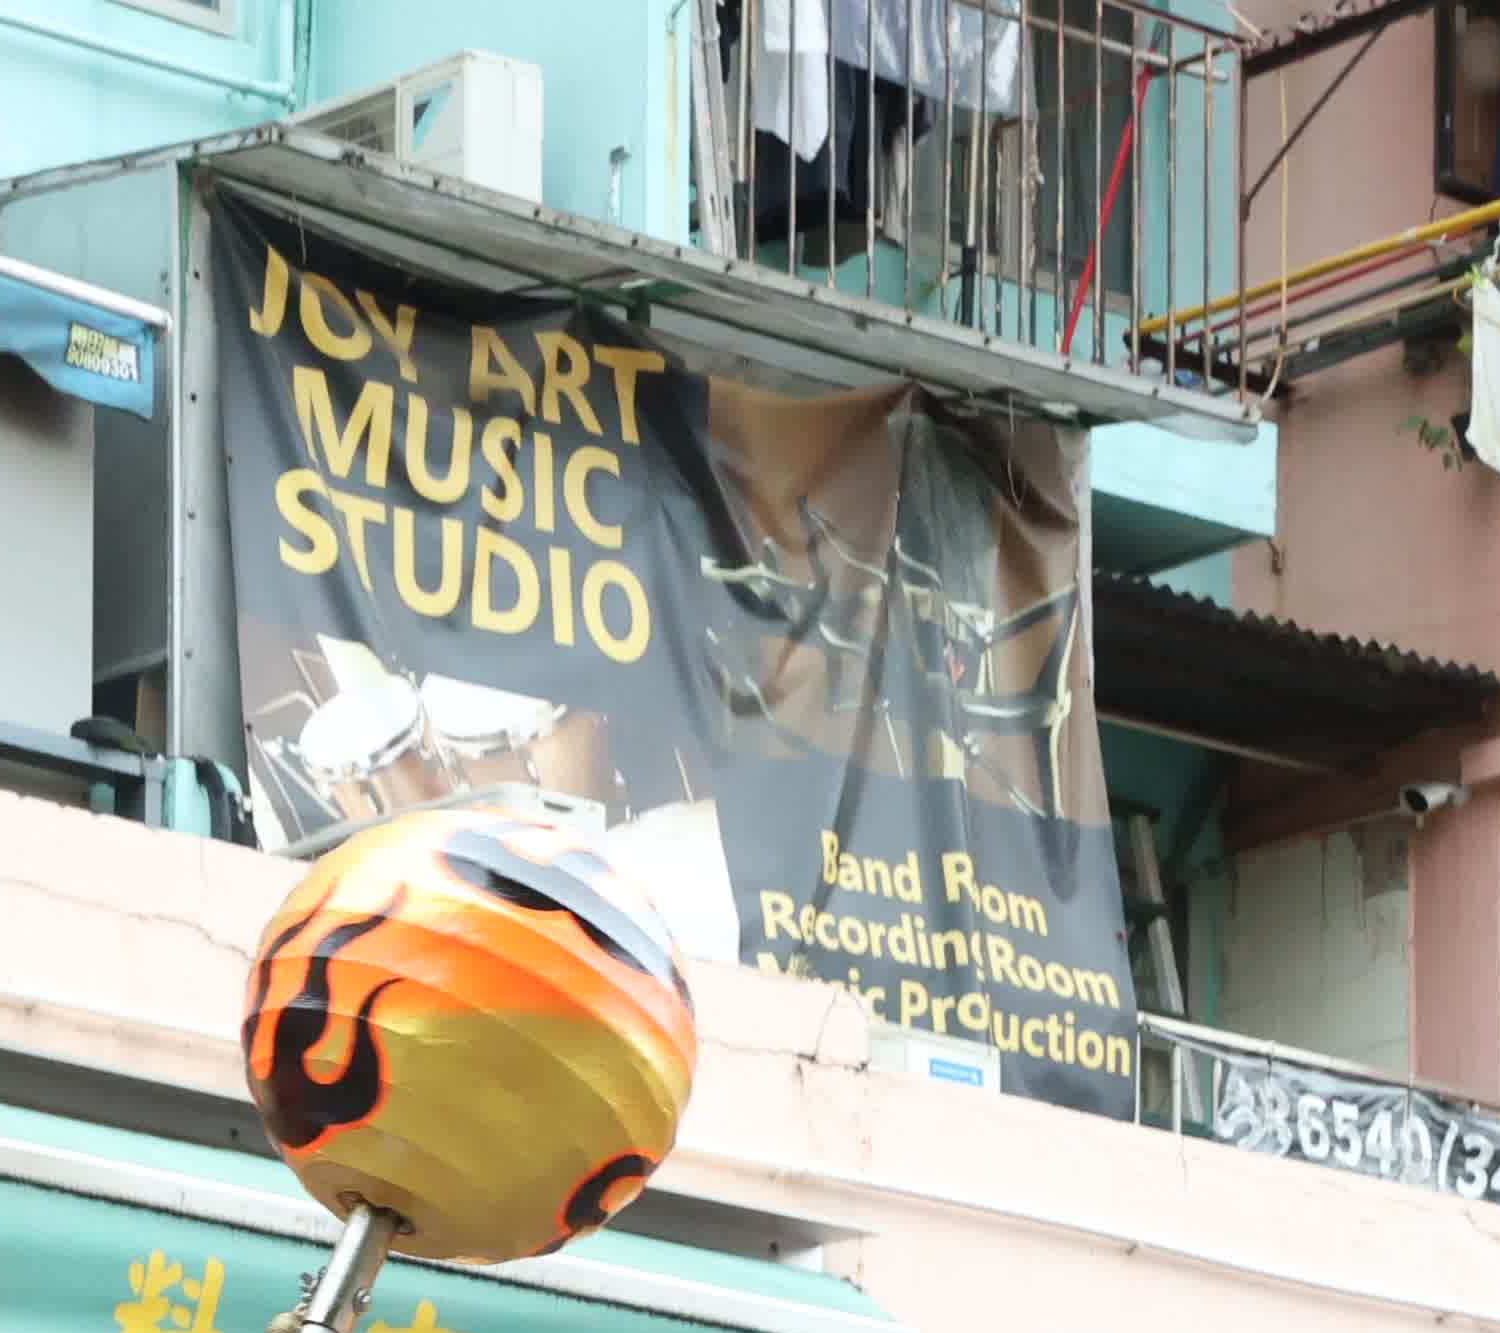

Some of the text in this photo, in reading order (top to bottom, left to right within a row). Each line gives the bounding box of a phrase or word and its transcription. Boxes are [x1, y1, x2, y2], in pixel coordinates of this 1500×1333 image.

[250, 244, 424, 384] JOY
[468, 323, 667, 446] ART
[290, 368, 624, 549] MUSIC
[275, 467, 652, 666] STUDIO
[820, 830, 923, 904] Band
[900, 980, 1131, 1077] Prouction
[987, 933, 1121, 1009] Room
